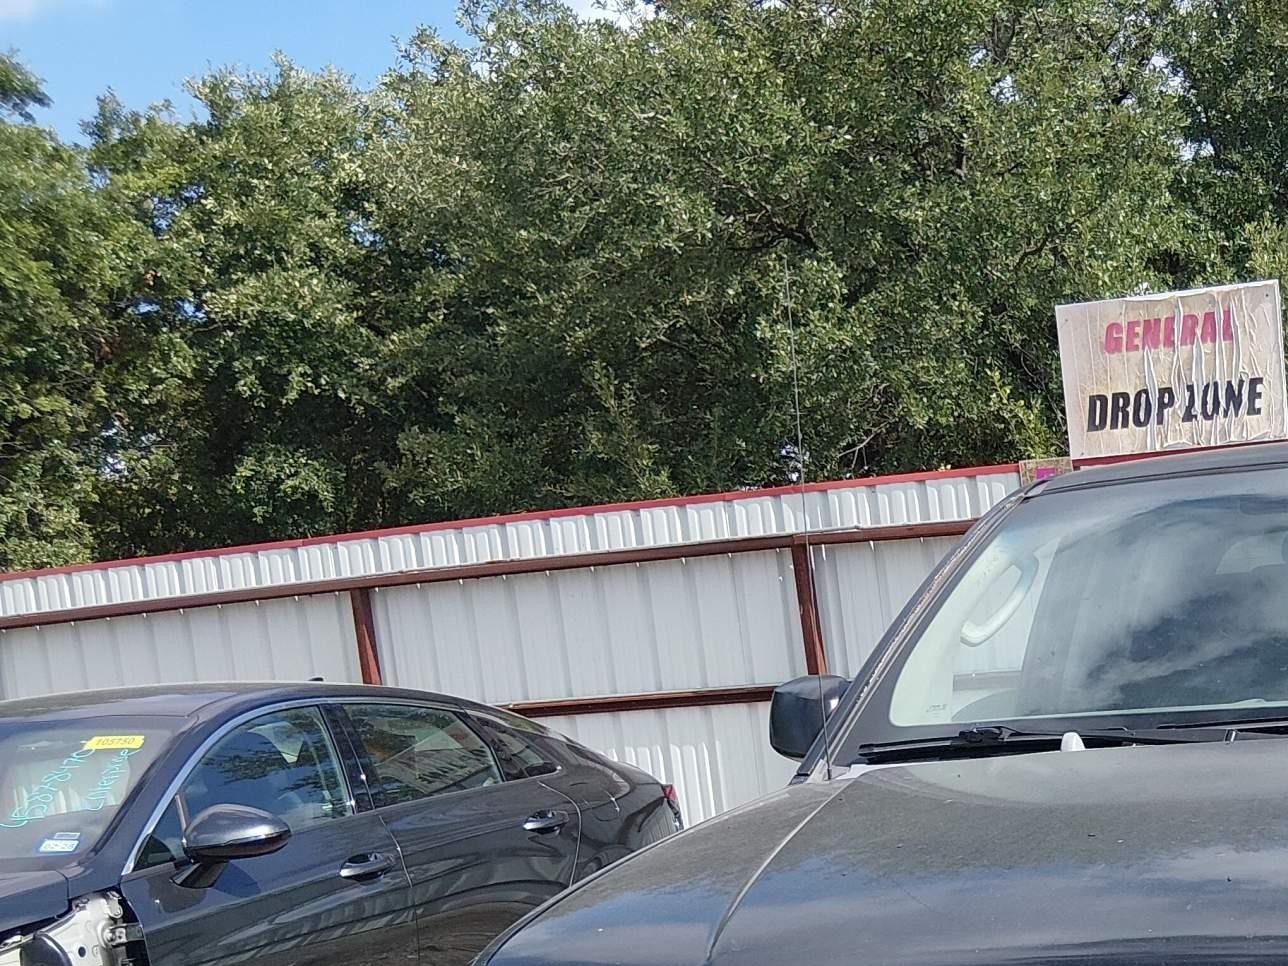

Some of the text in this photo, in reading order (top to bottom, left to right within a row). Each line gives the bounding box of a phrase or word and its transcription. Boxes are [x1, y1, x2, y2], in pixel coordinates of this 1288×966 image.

[1103, 309, 1234, 354] GENERAL
[1086, 377, 1264, 433] DROP ZONE
